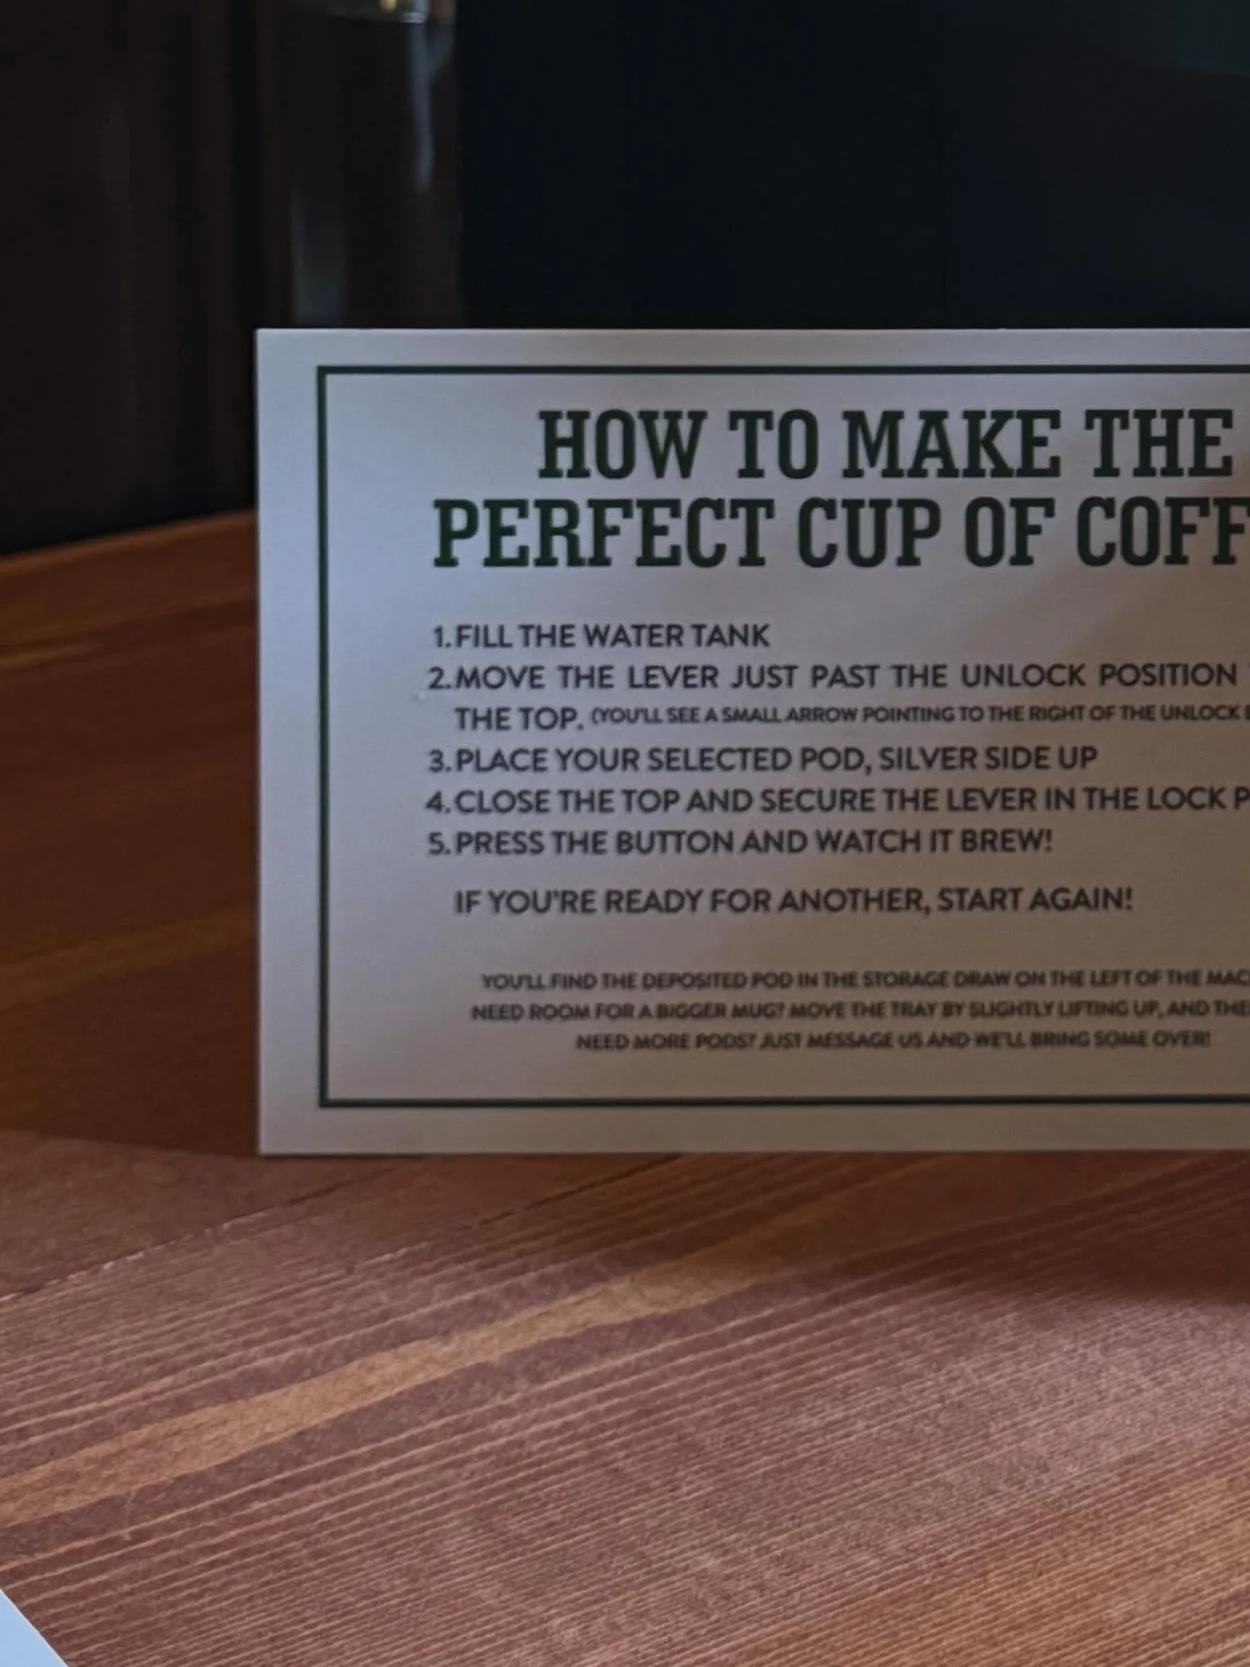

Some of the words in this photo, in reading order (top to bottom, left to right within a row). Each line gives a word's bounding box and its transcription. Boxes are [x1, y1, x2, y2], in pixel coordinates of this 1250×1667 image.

[537, 408, 709, 480] HOW
[728, 408, 819, 480] TO
[841, 409, 1062, 479] MAKE
[1084, 408, 1234, 478] THE
[432, 496, 776, 569] PERFECT
[797, 496, 942, 569] CUP
[964, 496, 1056, 568] OF
[518, 623, 576, 649] THE
[583, 623, 685, 648] WATER
[690, 623, 770, 648] TANK
[557, 665, 615, 690] THE
[628, 664, 719, 690] LEVER
[730, 664, 799, 690] JUST
[810, 664, 881, 689] PAST
[890, 663, 948, 689] THE
[961, 663, 1087, 688] UNLOCK
[1099, 662, 1237, 687] POSITION
[454, 706, 511, 731] THE
[666, 706, 700, 724] SEE
[704, 707, 719, 723] A
[721, 706, 782, 724] SMALL
[784, 706, 858, 723] ARROW
[862, 706, 956, 723] POINTING
[958, 705, 985, 723] TO
[988, 705, 1025, 723] THE
[1028, 704, 1086, 722] RIGHT
[1088, 704, 1116, 722] OF
[1119, 704, 1156, 722] THE
[1160, 704, 1241, 722] UNLOCK
[555, 747, 640, 773] YOUR
[647, 747, 793, 772] SELECTED
[800, 746, 873, 776] POD,
[879, 746, 978, 771] SILVER
[985, 745, 1051, 771] SIDE
[1058, 745, 1098, 770] UP
[557, 789, 615, 814] THE
[621, 788, 681, 814] TOP
[685, 788, 754, 813] AND
[760, 788, 876, 813] SECURE
[882, 787, 939, 812] THE
[947, 787, 1037, 812] LEVER
[1045, 787, 1076, 811] IN
[1082, 786, 1140, 812] THE
[1147, 786, 1227, 811] LOCK
[551, 830, 608, 856] THE
[615, 829, 734, 856] BUTTON
[740, 829, 808, 854] AND
[815, 828, 921, 854] WATCH
[929, 828, 954, 853] IT
[960, 828, 1053, 853] BREW!
[455, 889, 482, 914] IF
[487, 889, 597, 915] YOU'RE
[604, 888, 704, 914] READY
[710, 888, 772, 914] FOR
[777, 887, 931, 916] ANOTHER,
[937, 887, 1024, 912] START
[1028, 886, 1133, 912] AGAIN!
[549, 973, 598, 991] FIND
[601, 972, 637, 990] THE
[641, 972, 748, 991] DEPOSITED
[750, 971, 794, 989] POD
[797, 972, 819, 988] IN
[823, 971, 858, 988] THE
[862, 970, 949, 989] STORAGE
[953, 970, 1012, 988] DRAW
[1014, 971, 1046, 988] ON
[1050, 970, 1085, 988] THE
[1090, 969, 1132, 988] LEFT
[1134, 969, 1161, 987] OF
[1167, 969, 1201, 987] THE
[471, 1003, 525, 1022] NEED
[528, 1003, 590, 1021] ROOM
[595, 1003, 635, 1020] FOR
[638, 1005, 653, 1019] A
[656, 1002, 727, 1020] BIGGER
[731, 1002, 785, 1019] MUG?
[789, 1001, 844, 1019] MOVE
[852, 1001, 885, 1019] THE
[891, 1001, 937, 1018] TRAY
[942, 1001, 964, 1019] BY
[969, 1001, 1054, 1018] SLIGHTLY
[1058, 1000, 1129, 1017] LIFTING
[1133, 1000, 1164, 1019] UP,
[1166, 1000, 1211, 1017] AND
[576, 1033, 630, 1051] NEED
[632, 1033, 690, 1051] MORE
[695, 1033, 757, 1050] PODS?
[759, 1032, 802, 1050] JUST
[806, 1032, 894, 1049] MESSAGE
[898, 1032, 924, 1049] US
[926, 1031, 971, 1049] AND
[1029, 1031, 1091, 1049] BRING
[1093, 1030, 1148, 1049] SOME
[1152, 1030, 1211, 1047] OVER!
